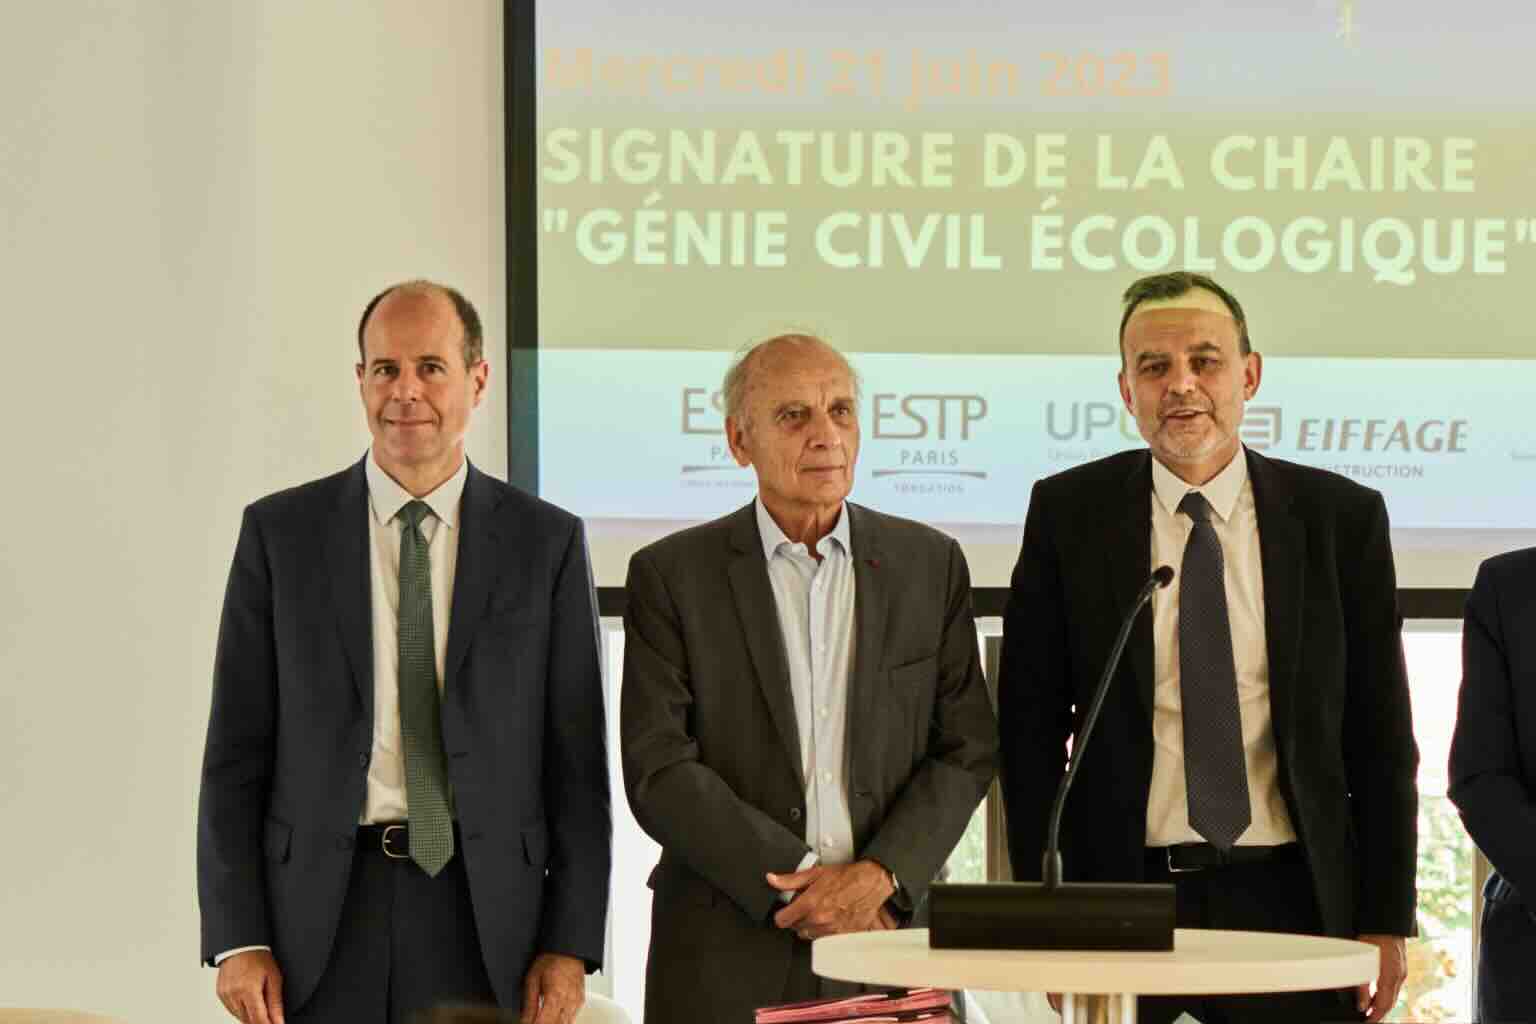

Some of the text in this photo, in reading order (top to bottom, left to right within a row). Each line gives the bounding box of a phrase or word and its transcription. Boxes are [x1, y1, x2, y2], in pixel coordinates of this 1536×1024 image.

[542, 47, 1172, 112] Mercredi 21 juin 2023
[543, 128, 1478, 193] SIGNATURE DE LA CHAIRE
[543, 190, 788, 267] "GÉNIE
[814, 211, 1003, 269] CIVIL
[872, 393, 988, 441] ESTP
[1296, 416, 1470, 453] EIFFAGE
[900, 448, 960, 466] PARIS
